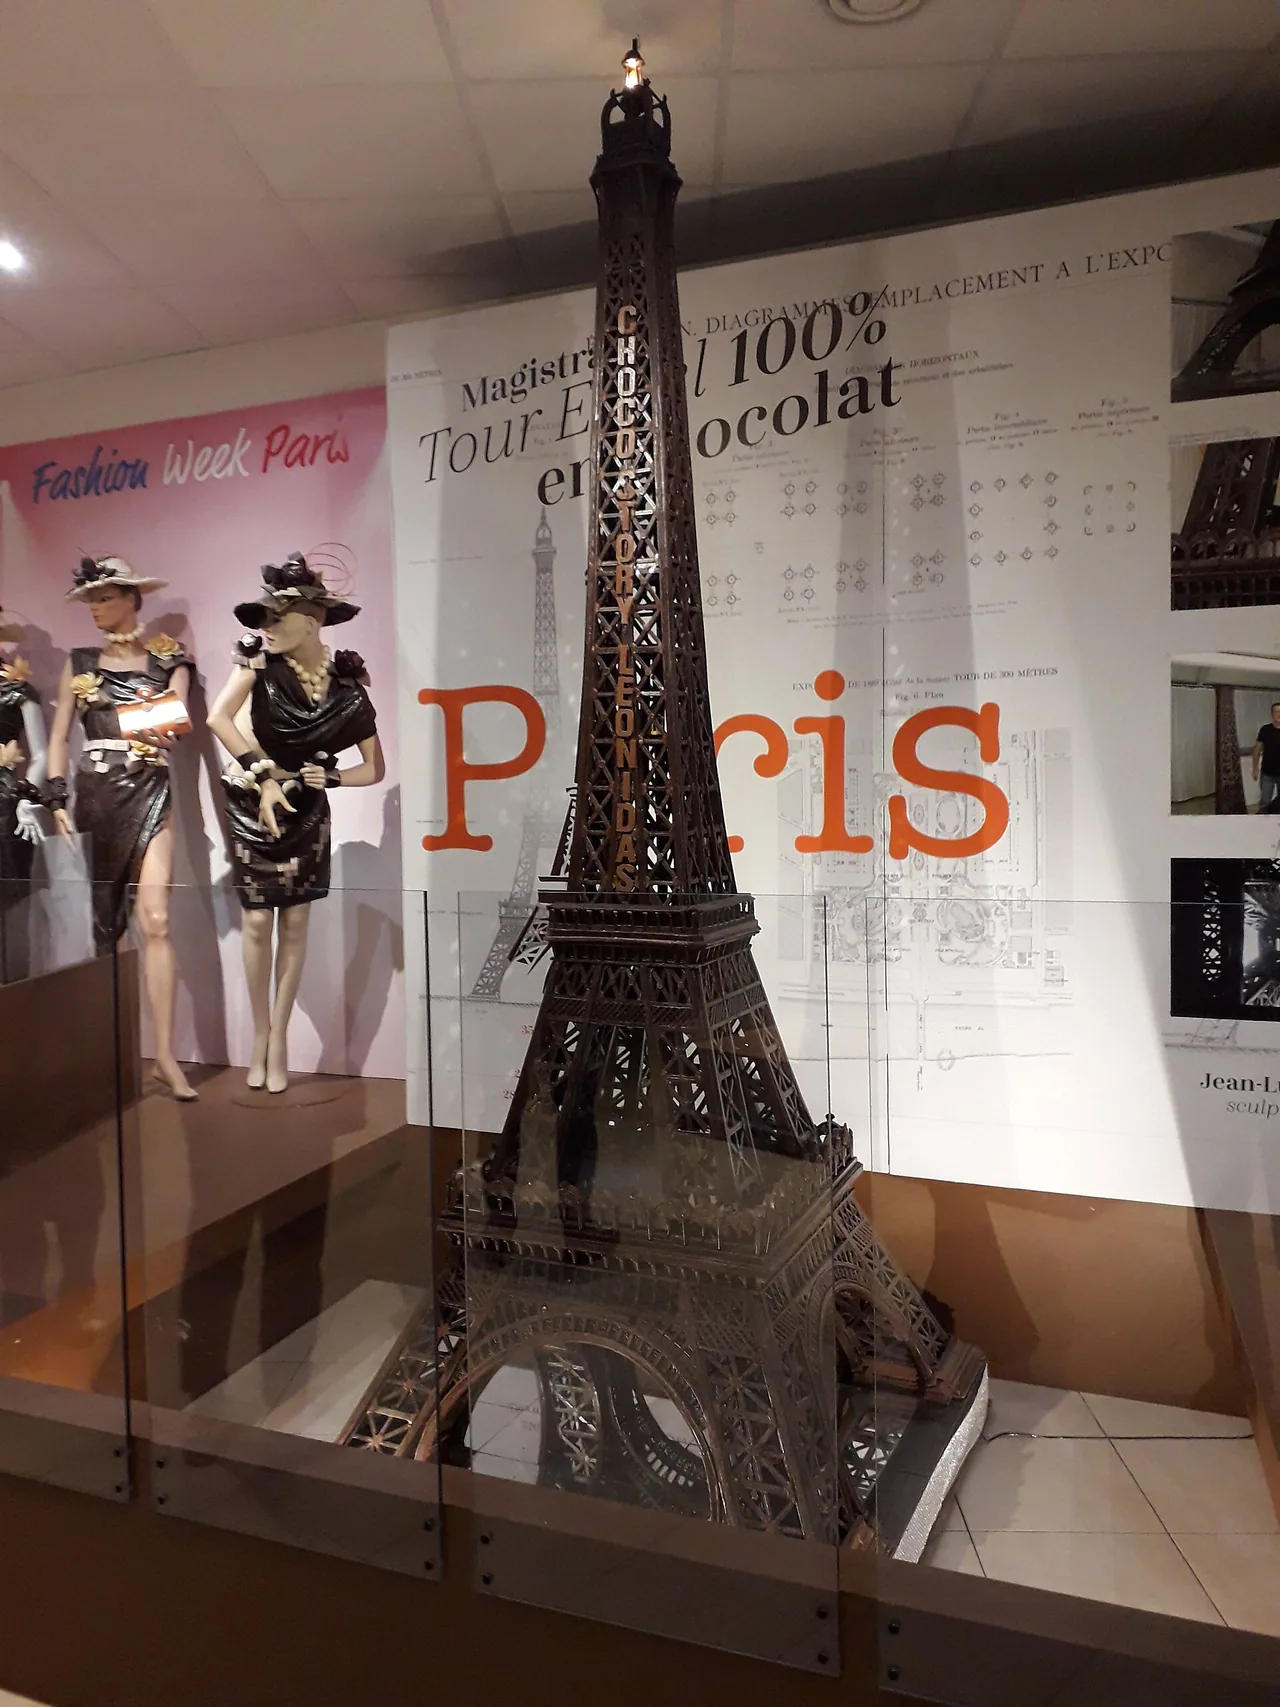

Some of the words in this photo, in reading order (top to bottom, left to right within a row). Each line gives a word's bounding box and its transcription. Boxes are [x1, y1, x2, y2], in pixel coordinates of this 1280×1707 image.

[1055, 260, 1071, 280] A
[419, 408, 543, 483] Tour
[728, 284, 888, 388] 100%
[696, 356, 902, 459] ocolat
[32, 446, 149, 504] Fashion
[162, 427, 252, 485] Week
[261, 414, 349, 474] Paris
[953, 671, 980, 681] TOUR
[983, 671, 997, 680] DE
[418, 670, 1009, 860] Pris
[614, 645, 637, 893] LEONIDAS
[1200, 1072, 1280, 1094] Jean-L
[1226, 1099, 1280, 1119] sculp
